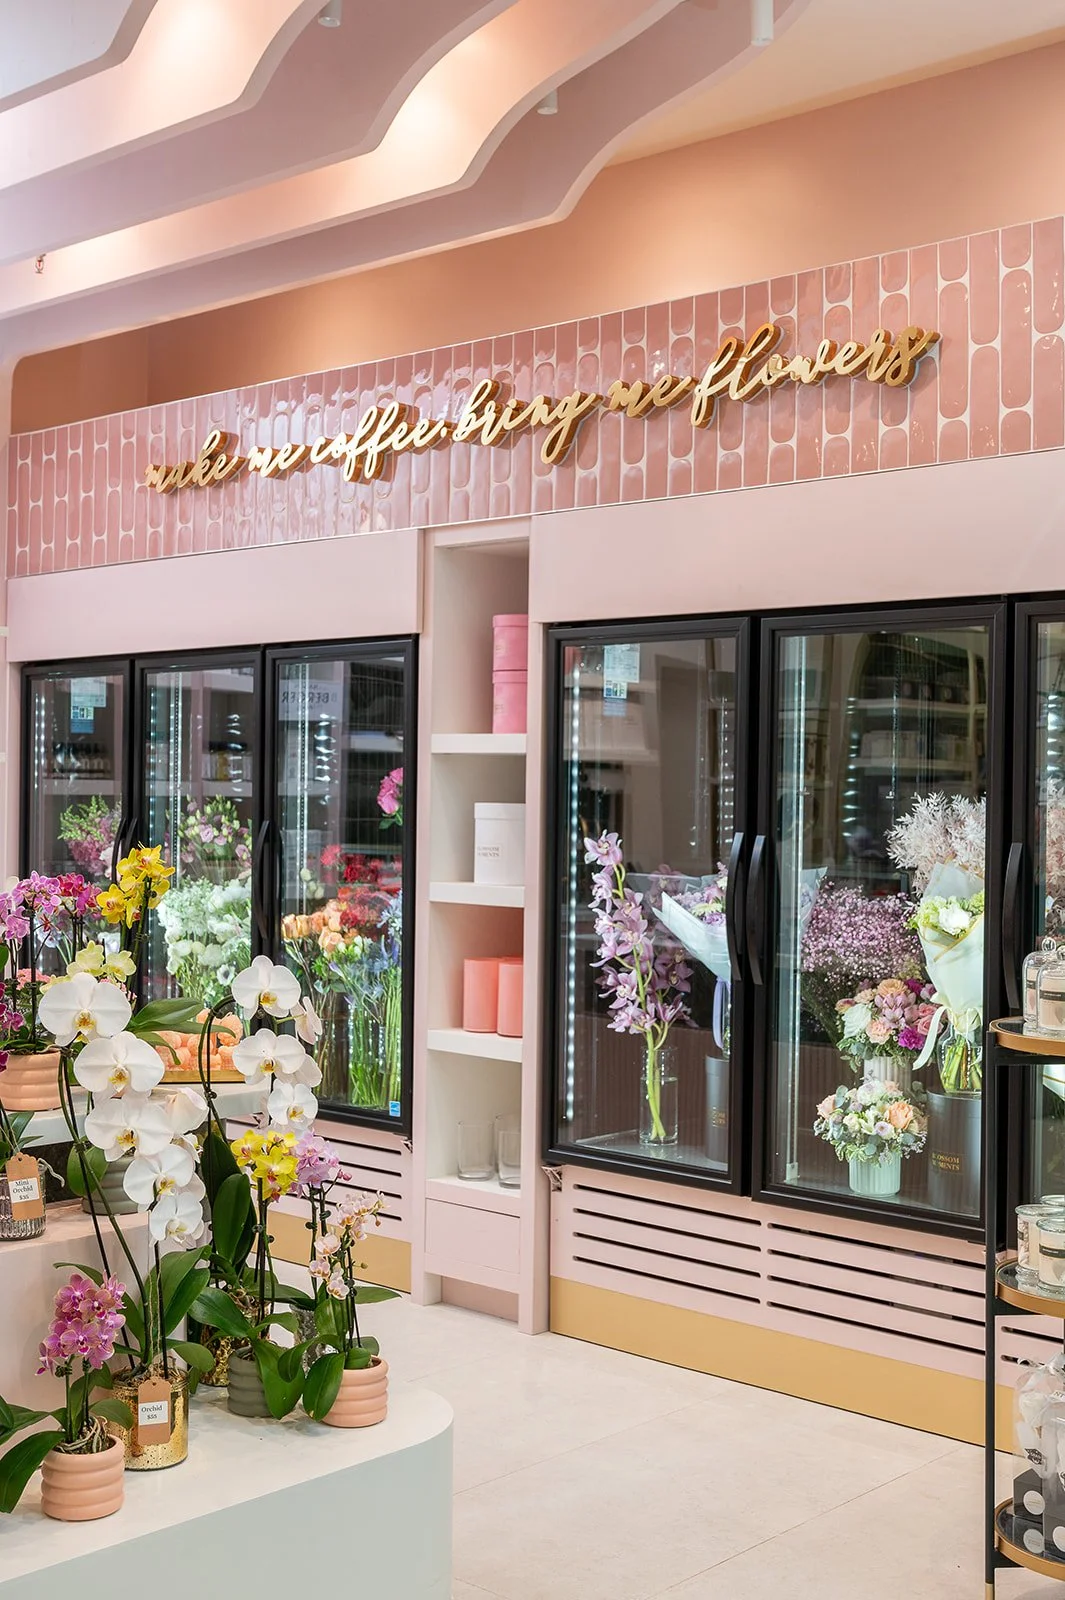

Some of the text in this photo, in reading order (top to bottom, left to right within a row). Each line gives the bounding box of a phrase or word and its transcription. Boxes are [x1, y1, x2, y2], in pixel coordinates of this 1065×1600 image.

[144, 429, 240, 494] make
[248, 442, 306, 478] me
[452, 378, 598, 465] bring
[608, 374, 693, 418] me
[691, 322, 939, 427] flowers
[13, 1185, 33, 1193] Orchid
[141, 1404, 163, 1412] Orchid
